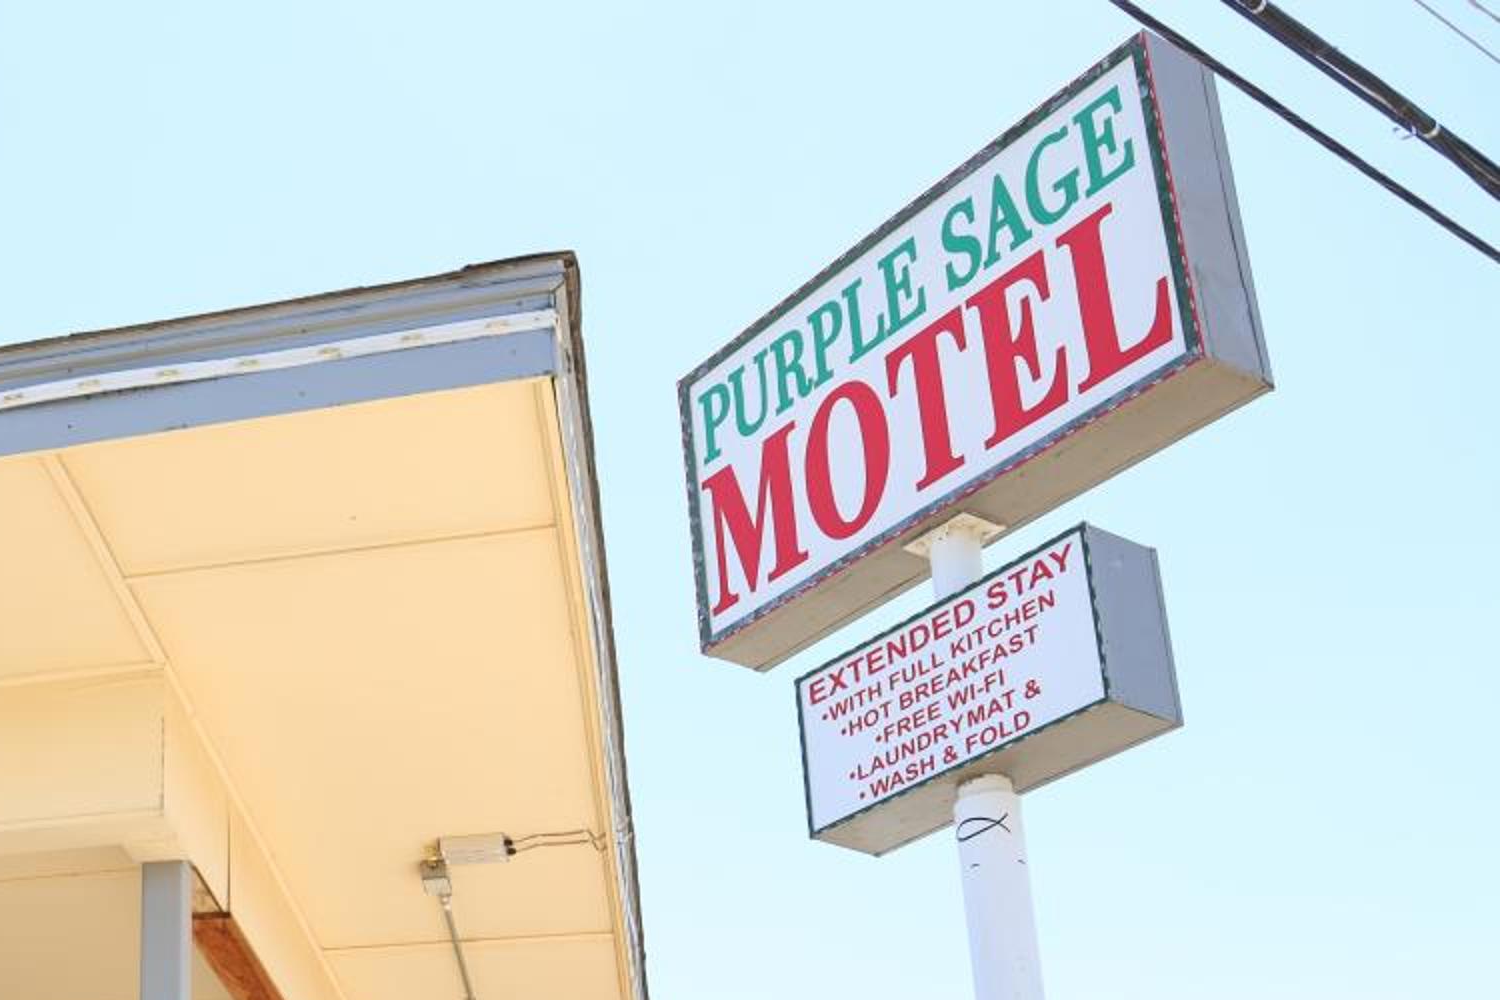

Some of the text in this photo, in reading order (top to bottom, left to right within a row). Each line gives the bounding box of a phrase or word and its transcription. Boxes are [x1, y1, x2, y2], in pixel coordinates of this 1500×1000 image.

[698, 86, 1136, 465] PURPLE SAGE
[702, 203, 1173, 616] MOTEL
[809, 543, 1072, 706] EXTENDED STAY
[889, 653, 944, 691] FULL
[951, 590, 1055, 658] KITCHEN
[901, 624, 1039, 711] BREAKFAST
[948, 669, 1006, 711] WI-FI
[1025, 679, 1041, 698] &
[944, 746, 958, 764] &
[965, 710, 1031, 755] FOLD
